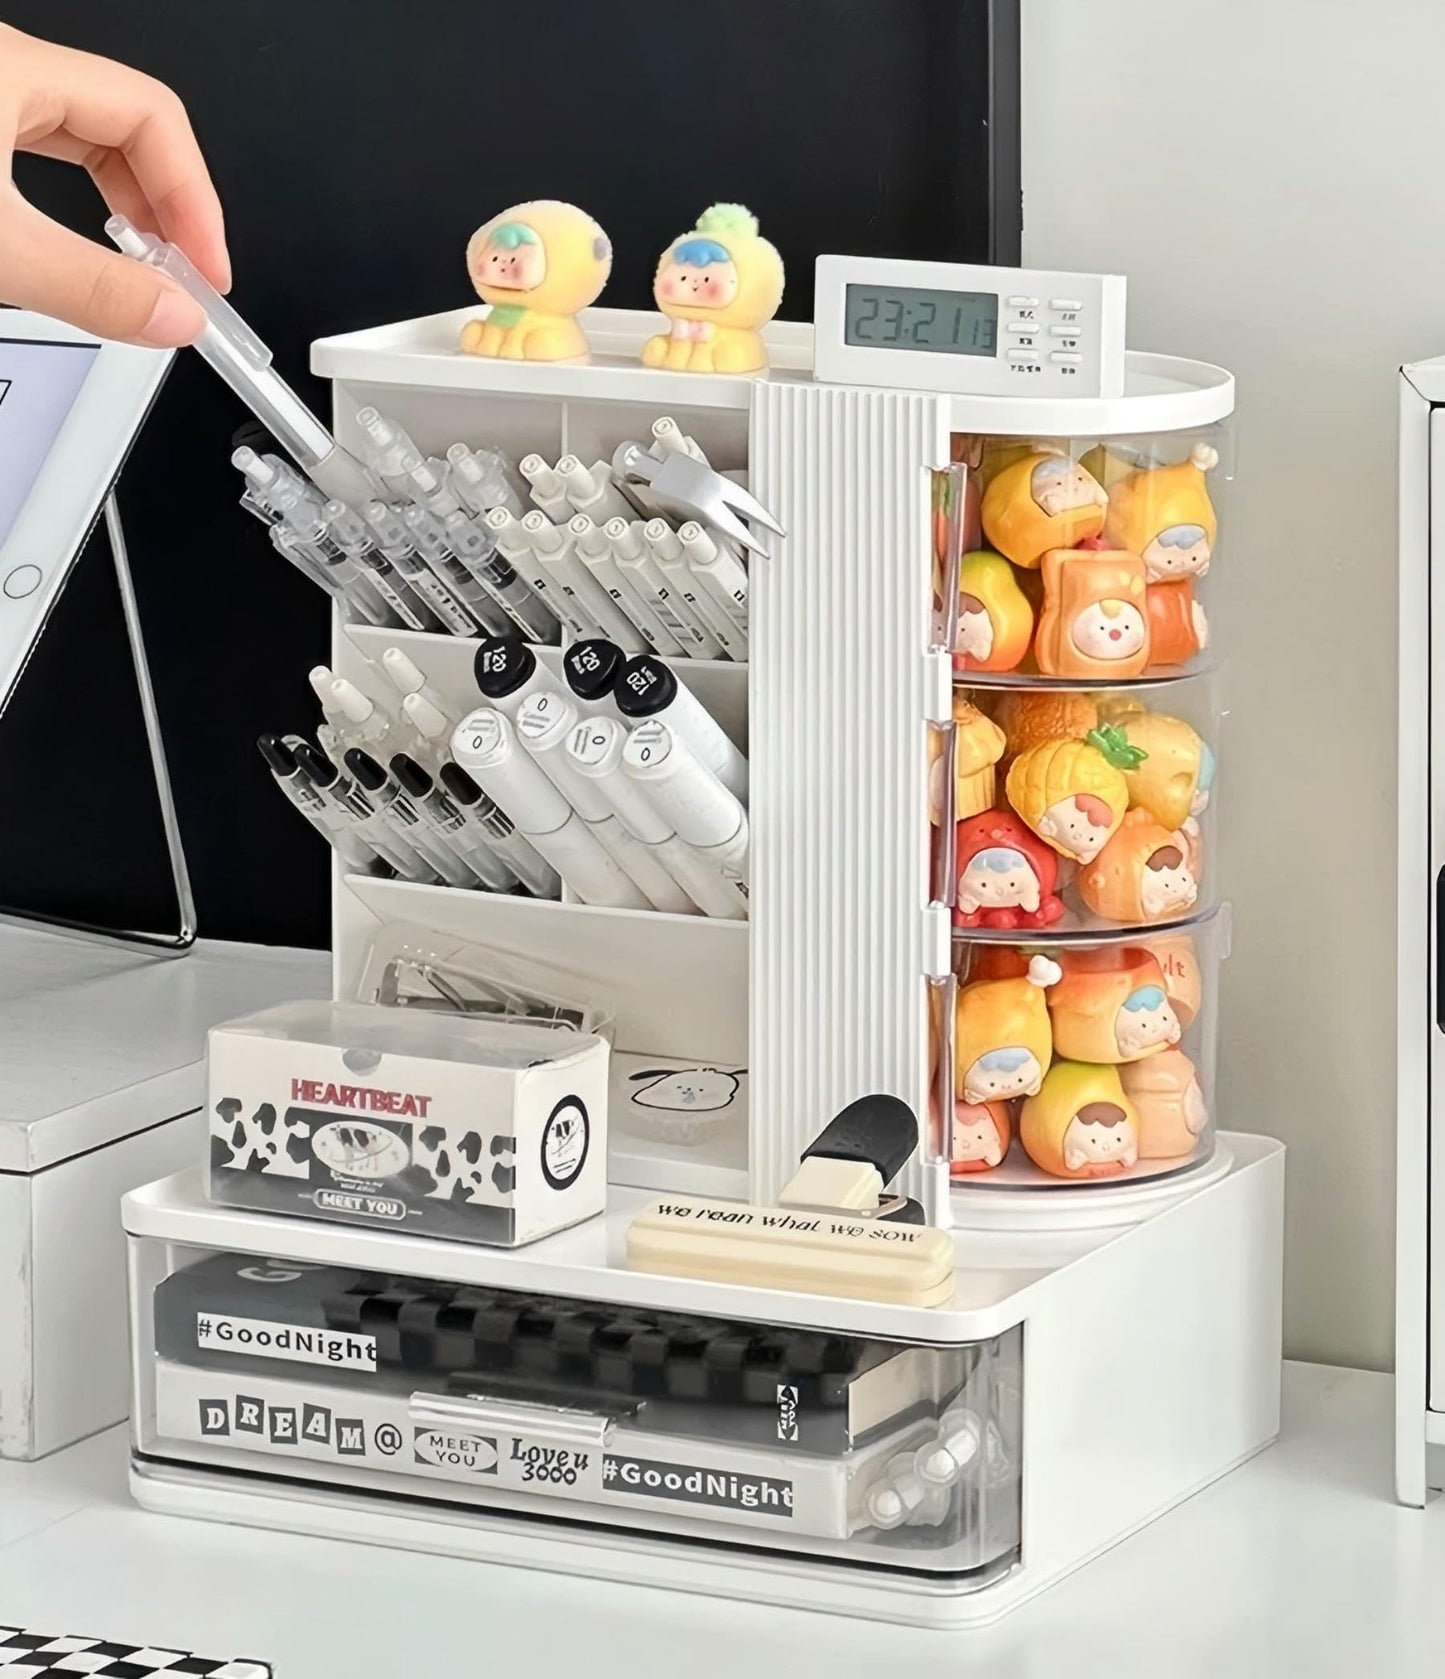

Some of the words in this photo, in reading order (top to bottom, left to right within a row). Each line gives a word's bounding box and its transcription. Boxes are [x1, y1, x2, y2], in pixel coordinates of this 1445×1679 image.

[854, 298, 962, 344] 23:21
[579, 646, 601, 671] 120
[626, 671, 650, 696] 120
[291, 1078, 432, 1118] HEARTBEAT
[321, 1192, 363, 1210] MEET
[366, 1199, 398, 1215] YOU
[198, 1318, 376, 1362] #GoodNight
[429, 1434, 481, 1453] MEET
[435, 1450, 476, 1467] YOU
[521, 1462, 577, 1486] 3000
[602, 1459, 793, 1507] #GoodNight
